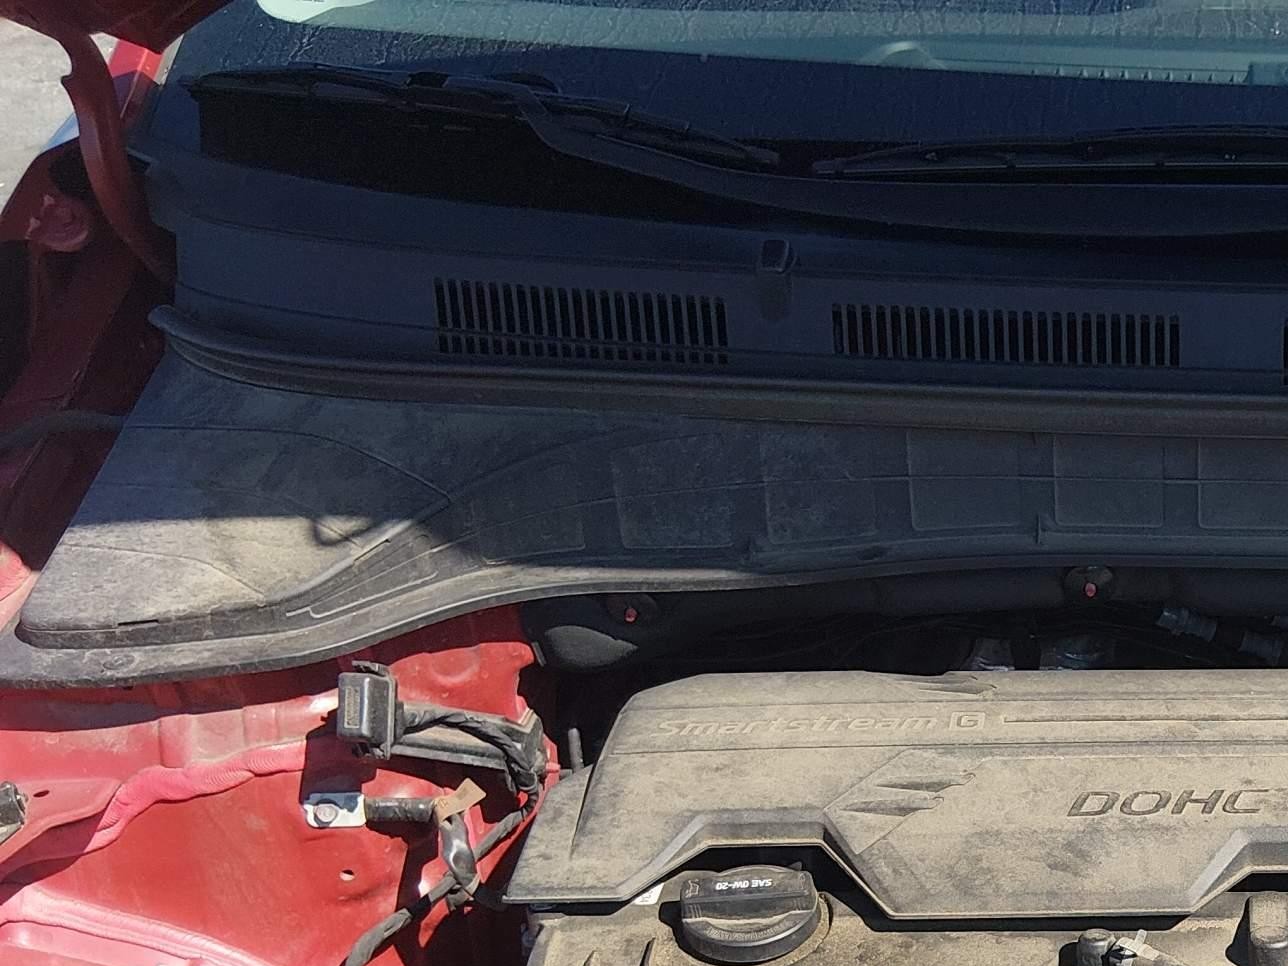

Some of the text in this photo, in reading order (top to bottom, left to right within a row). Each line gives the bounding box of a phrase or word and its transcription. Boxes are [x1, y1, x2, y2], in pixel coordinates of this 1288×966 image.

[654, 714, 938, 737] Smartstream
[1067, 788, 1269, 818] DOHC
[715, 878, 773, 891] SAE 0W-20
